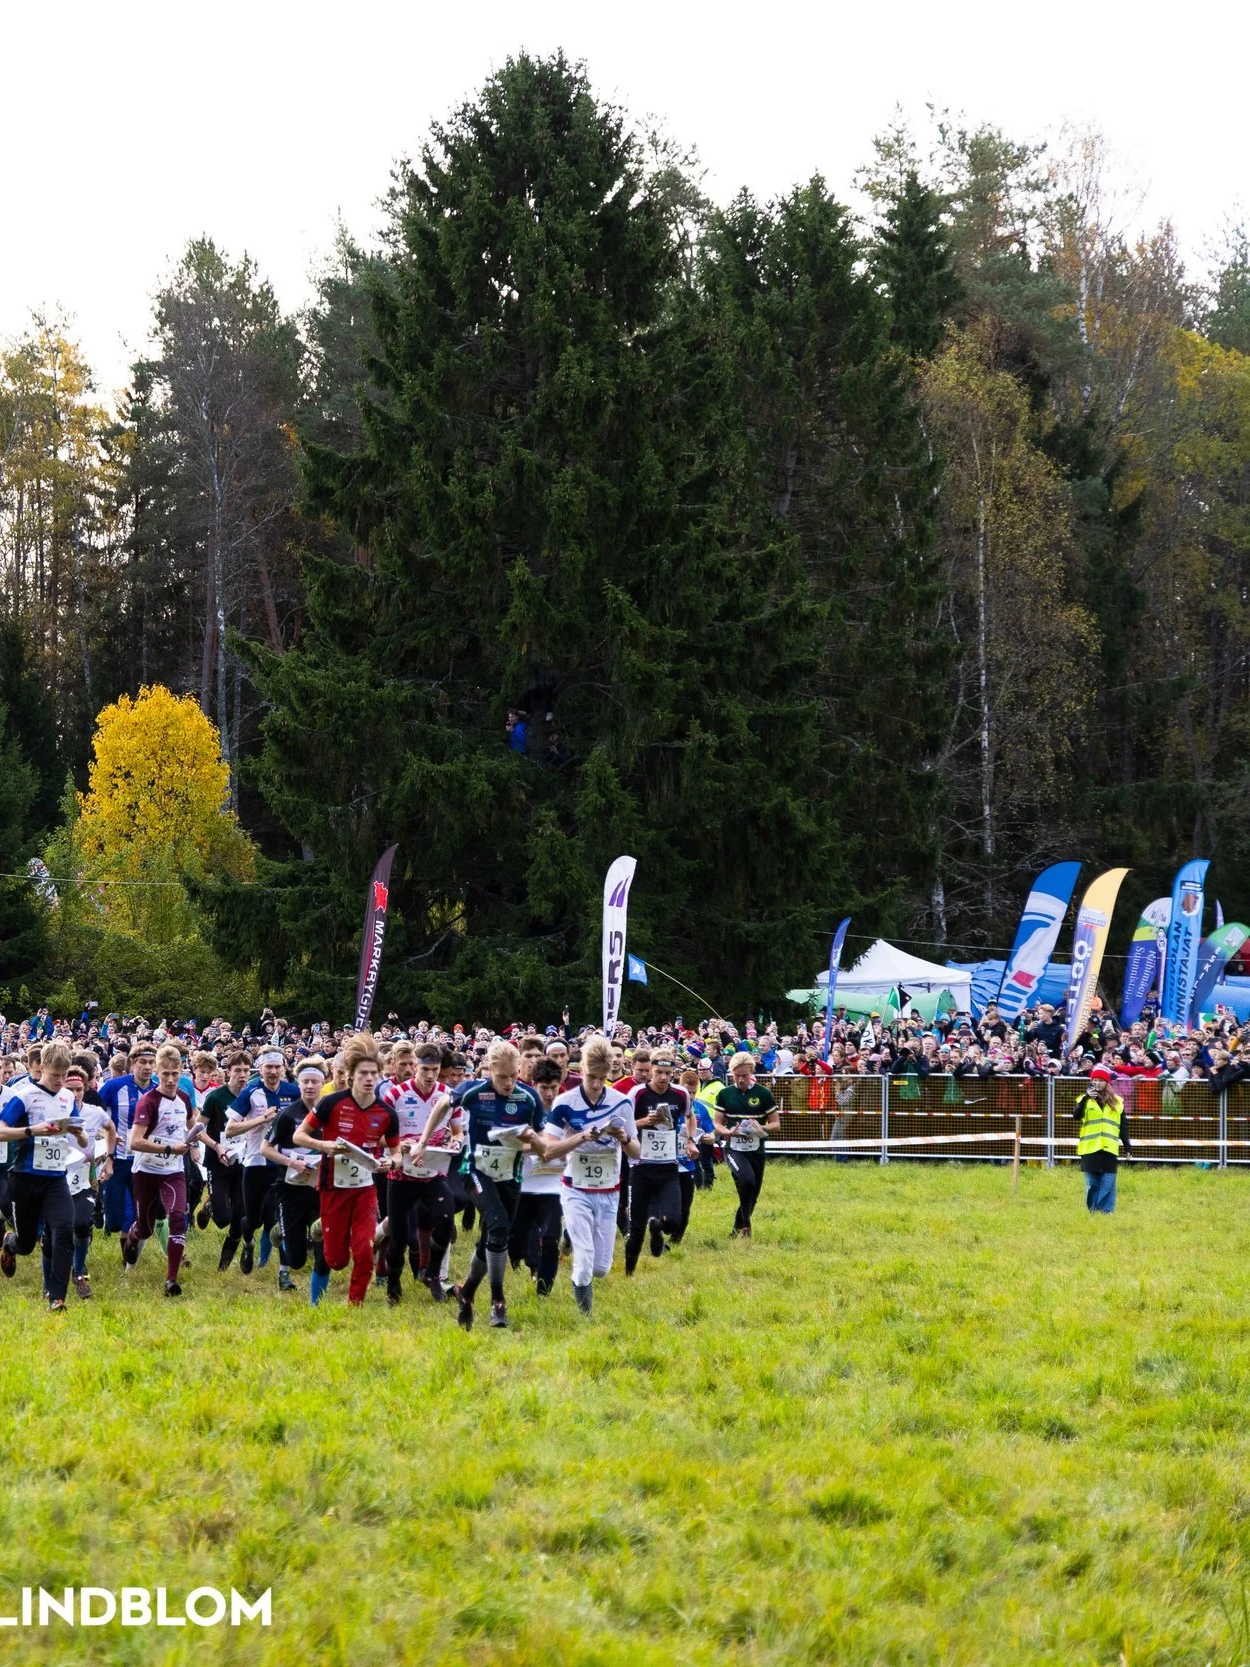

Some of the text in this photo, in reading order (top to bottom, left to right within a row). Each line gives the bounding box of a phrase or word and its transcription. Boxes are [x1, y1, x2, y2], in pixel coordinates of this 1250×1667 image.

[1169, 921, 1183, 1012] KOUVOLAN
[1124, 945, 1146, 1004] Suunnistajat
[1136, 950, 1157, 998] Riihimäen
[651, 1140, 667, 1151] 37
[45, 1148, 61, 1161] 30
[490, 1158, 499, 1171] 4
[350, 1166, 359, 1178] 2
[584, 1166, 603, 1178] 19
